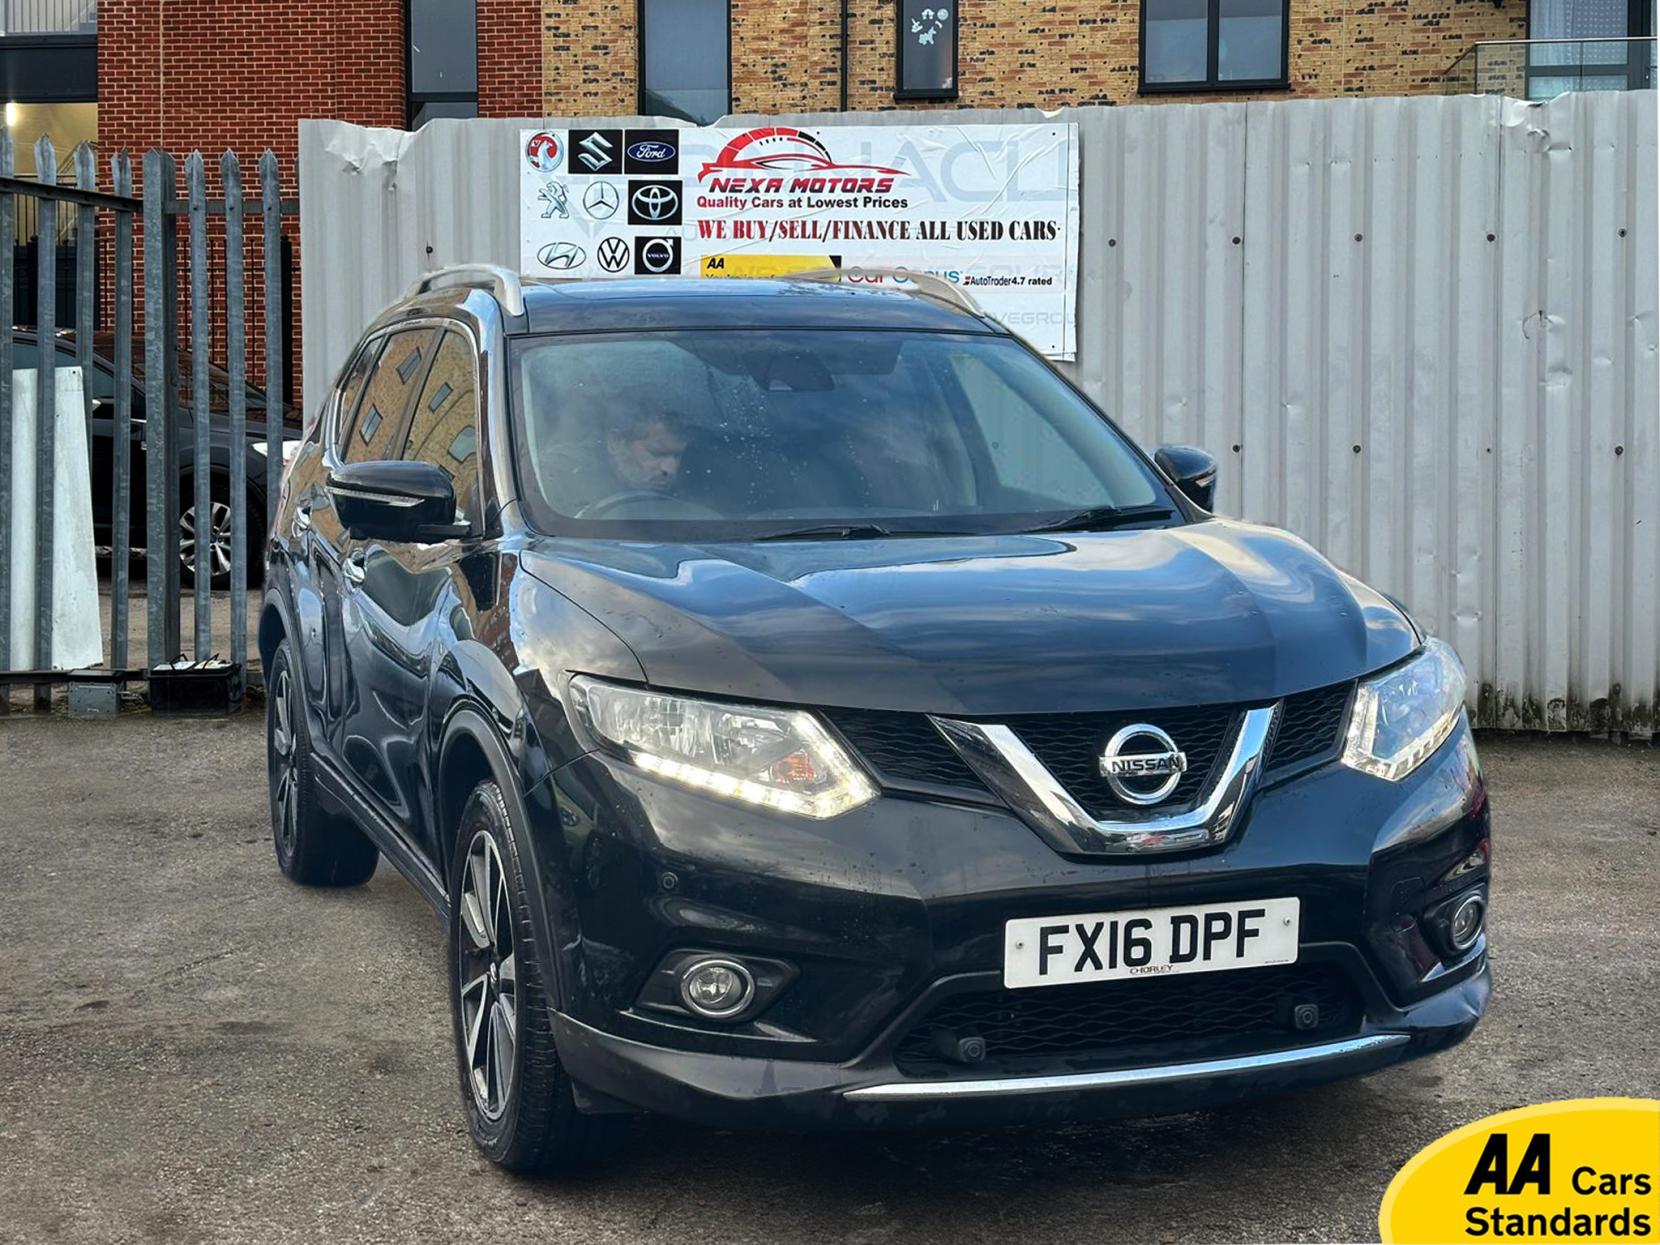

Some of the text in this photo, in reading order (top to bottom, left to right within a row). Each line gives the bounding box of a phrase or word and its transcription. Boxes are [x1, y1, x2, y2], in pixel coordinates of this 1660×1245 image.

[636, 144, 666, 158] Ford
[709, 178, 895, 193] NEXA MOTORS
[697, 196, 908, 210] Quality Cars at Lowest Prices
[698, 220, 727, 240] WE
[916, 220, 950, 240] ALL
[957, 220, 1003, 240] USED
[707, 257, 725, 269] AA
[1011, 276, 1026, 286] 4.7
[1028, 276, 1053, 286] rated
[1112, 753, 1184, 773] NISSAN
[1039, 908, 1266, 976] FX16 DPF
[1129, 964, 1174, 975] CHORLEY
